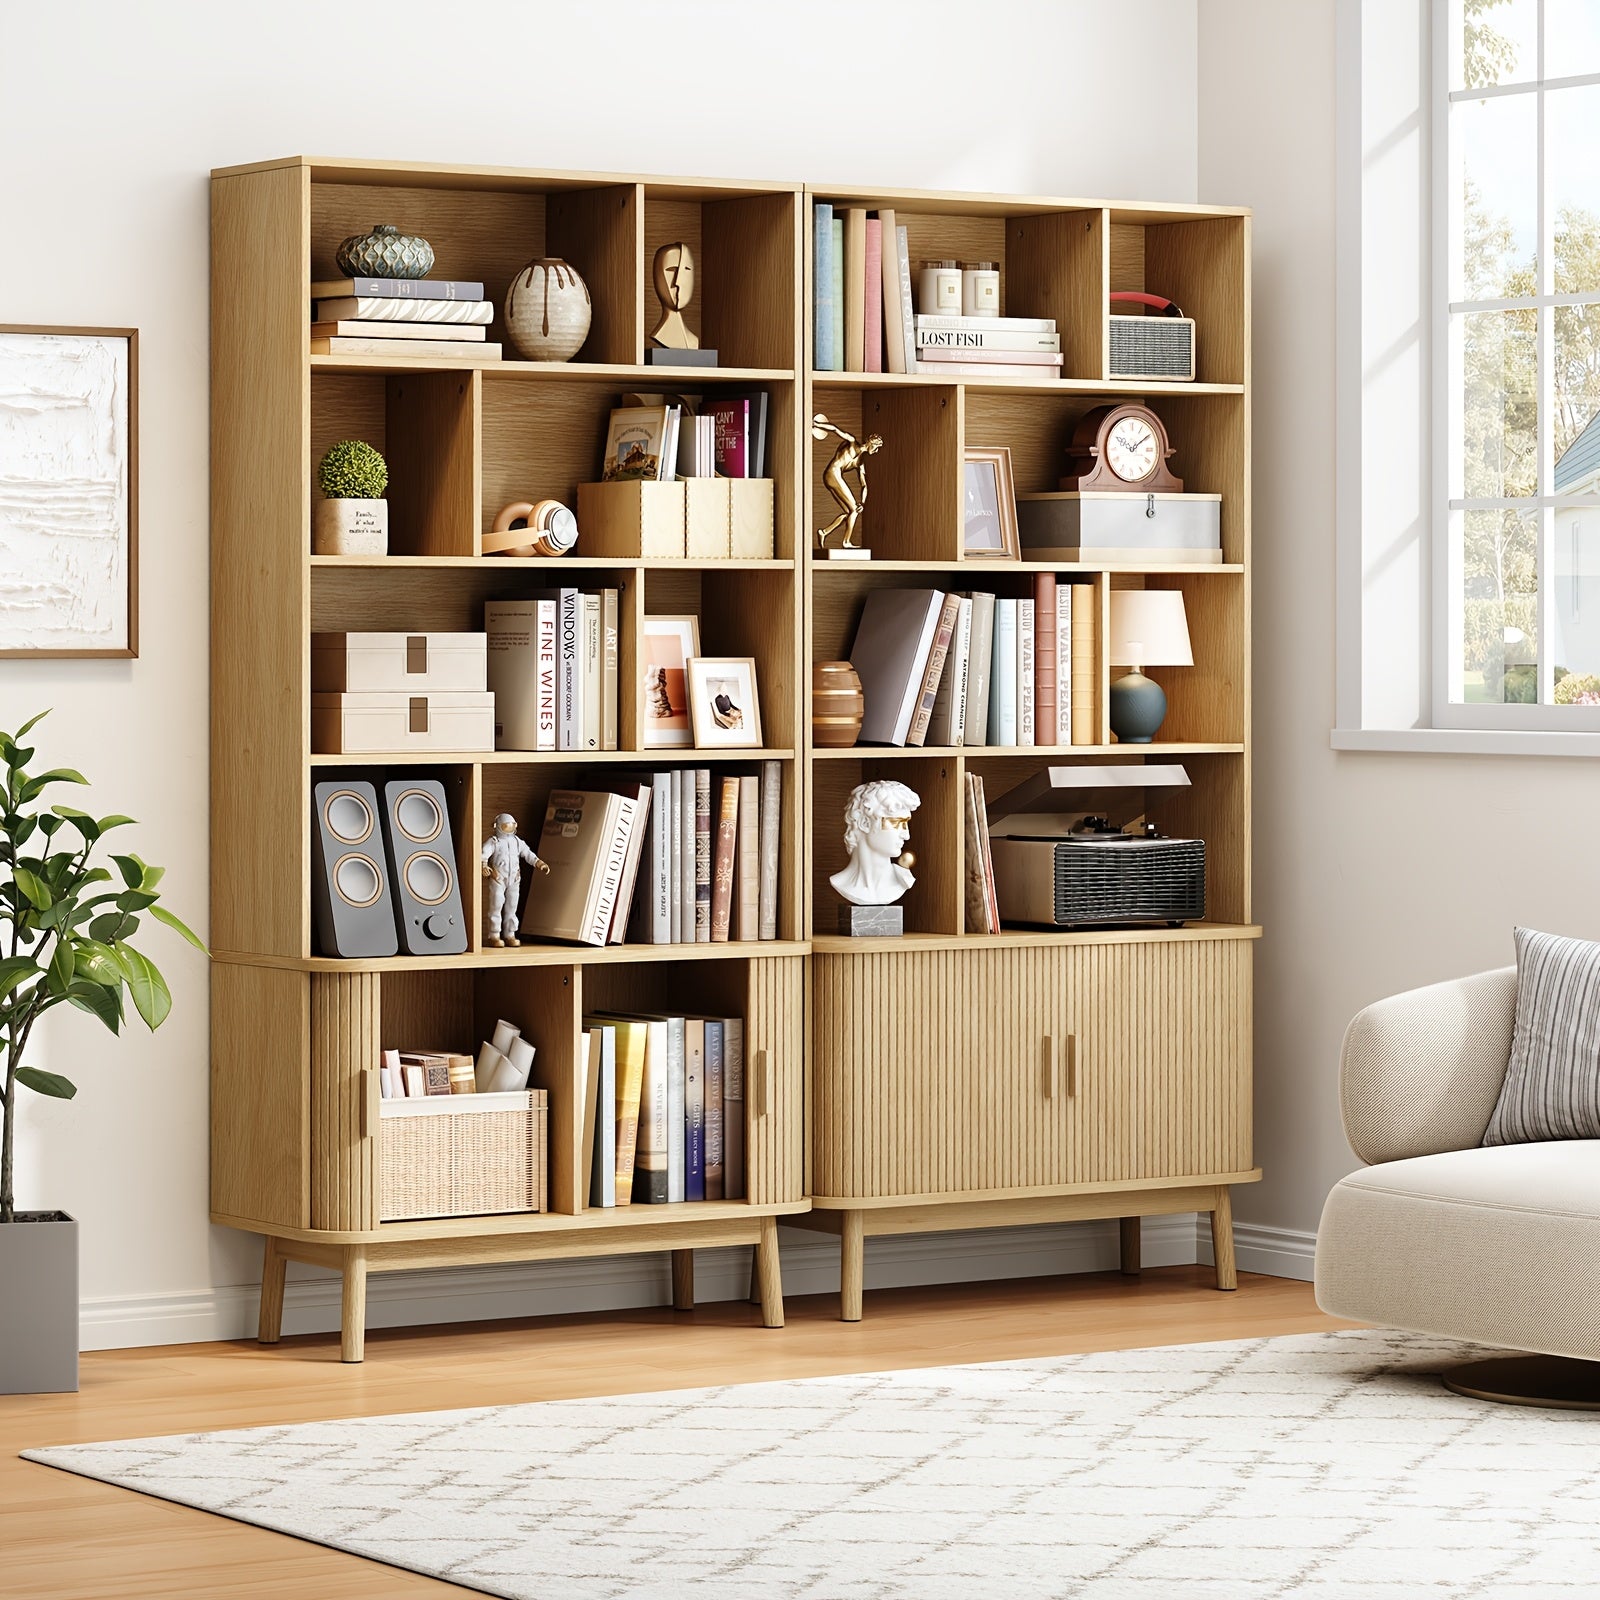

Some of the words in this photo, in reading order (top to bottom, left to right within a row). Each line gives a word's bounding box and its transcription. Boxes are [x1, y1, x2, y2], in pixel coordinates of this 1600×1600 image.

[922, 332, 953, 345] LOST
[956, 333, 983, 347] FISH
[716, 411, 734, 425] CAN'T
[725, 437, 737, 449] THE
[541, 621, 553, 662] FINE
[563, 593, 575, 660] WINDOWS
[606, 626, 617, 653] ART
[1023, 637, 1032, 673] WAR
[1060, 627, 1069, 665] WAR
[541, 670, 553, 730] WINES
[1023, 686, 1032, 734] PEACE
[1060, 679, 1069, 732] PEACE
[711, 1055, 720, 1073] AND
[711, 1075, 720, 1101] STEVE
[624, 1153, 633, 1172] YOU
[711, 1123, 720, 1168] VACATION
